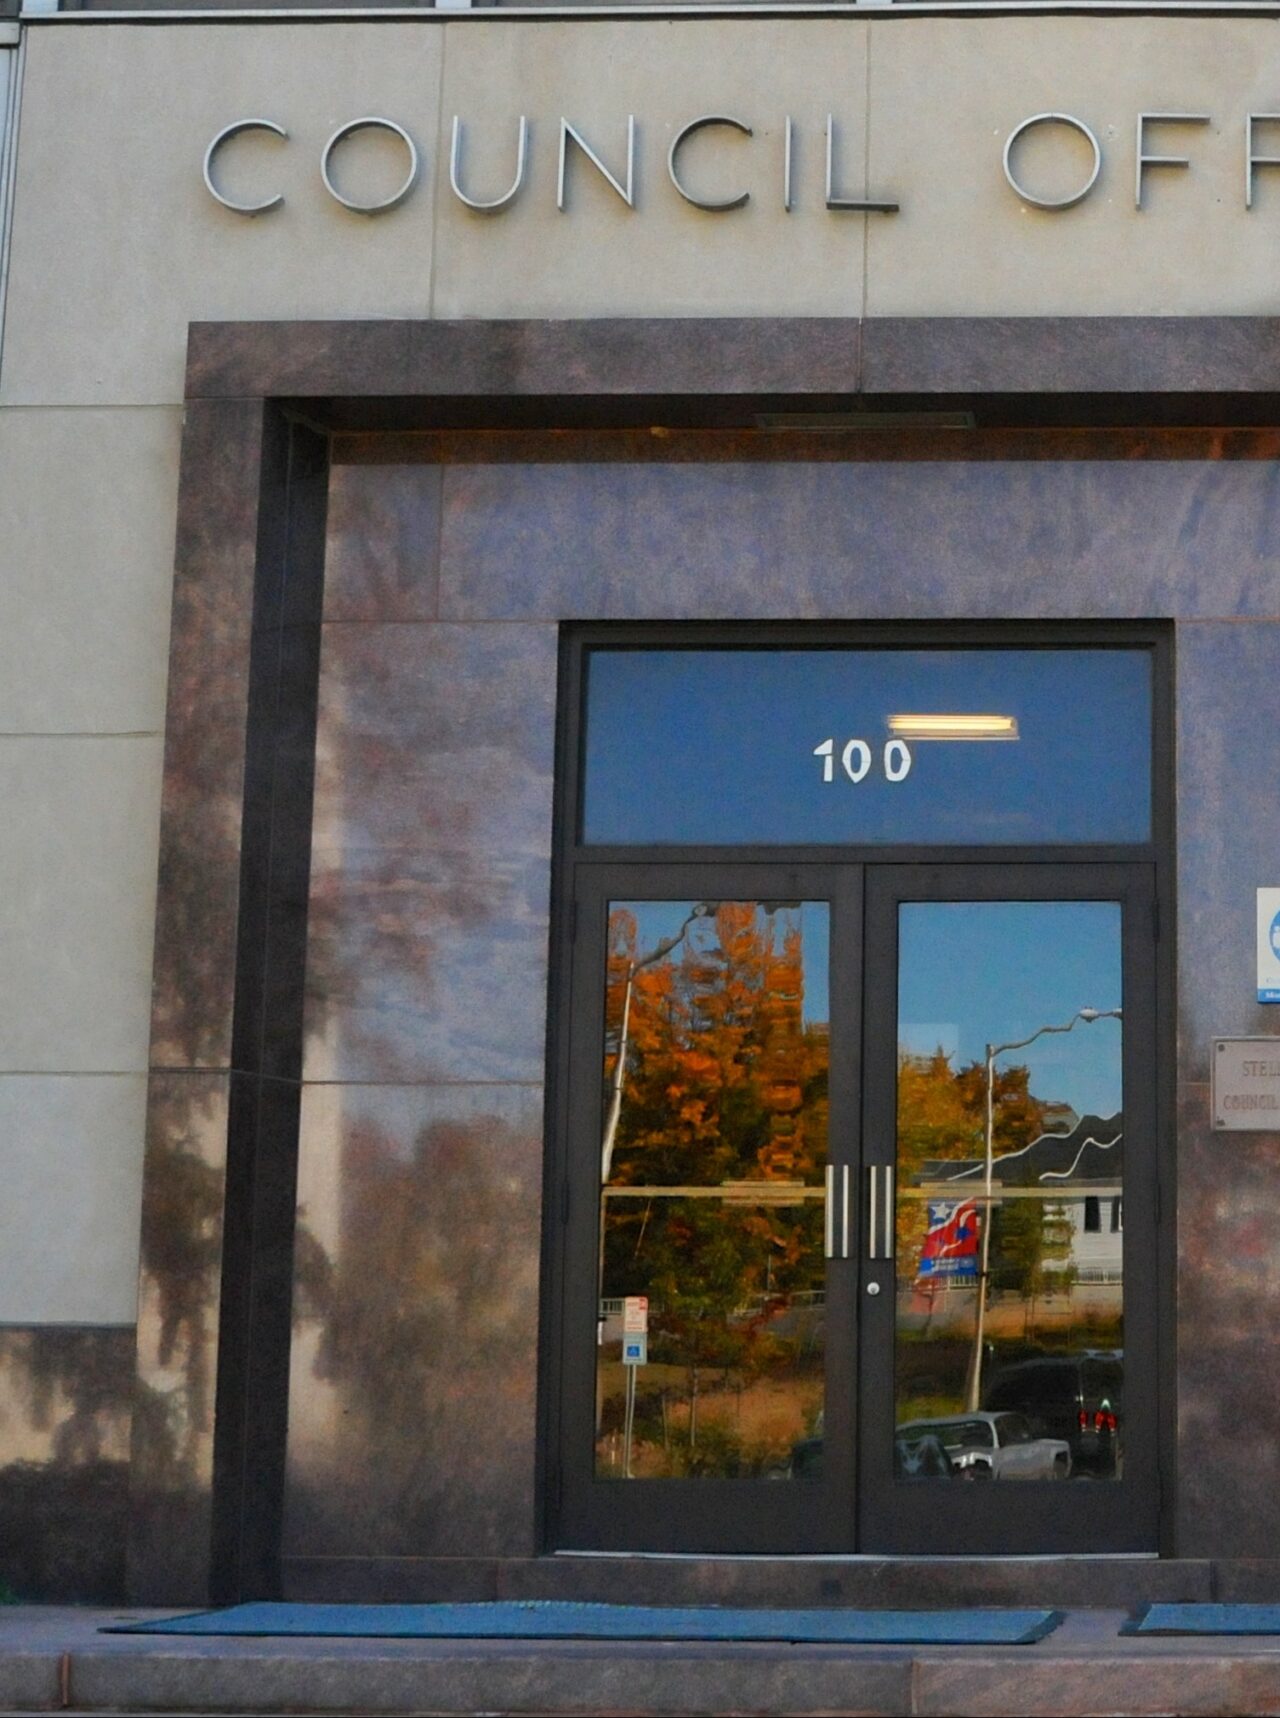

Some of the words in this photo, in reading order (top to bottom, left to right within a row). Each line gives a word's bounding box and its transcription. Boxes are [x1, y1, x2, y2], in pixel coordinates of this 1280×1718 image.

[203, 113, 900, 214] COUNCIL
[813, 738, 911, 783] 100
[1223, 1094, 1279, 1111] COUNCIL
